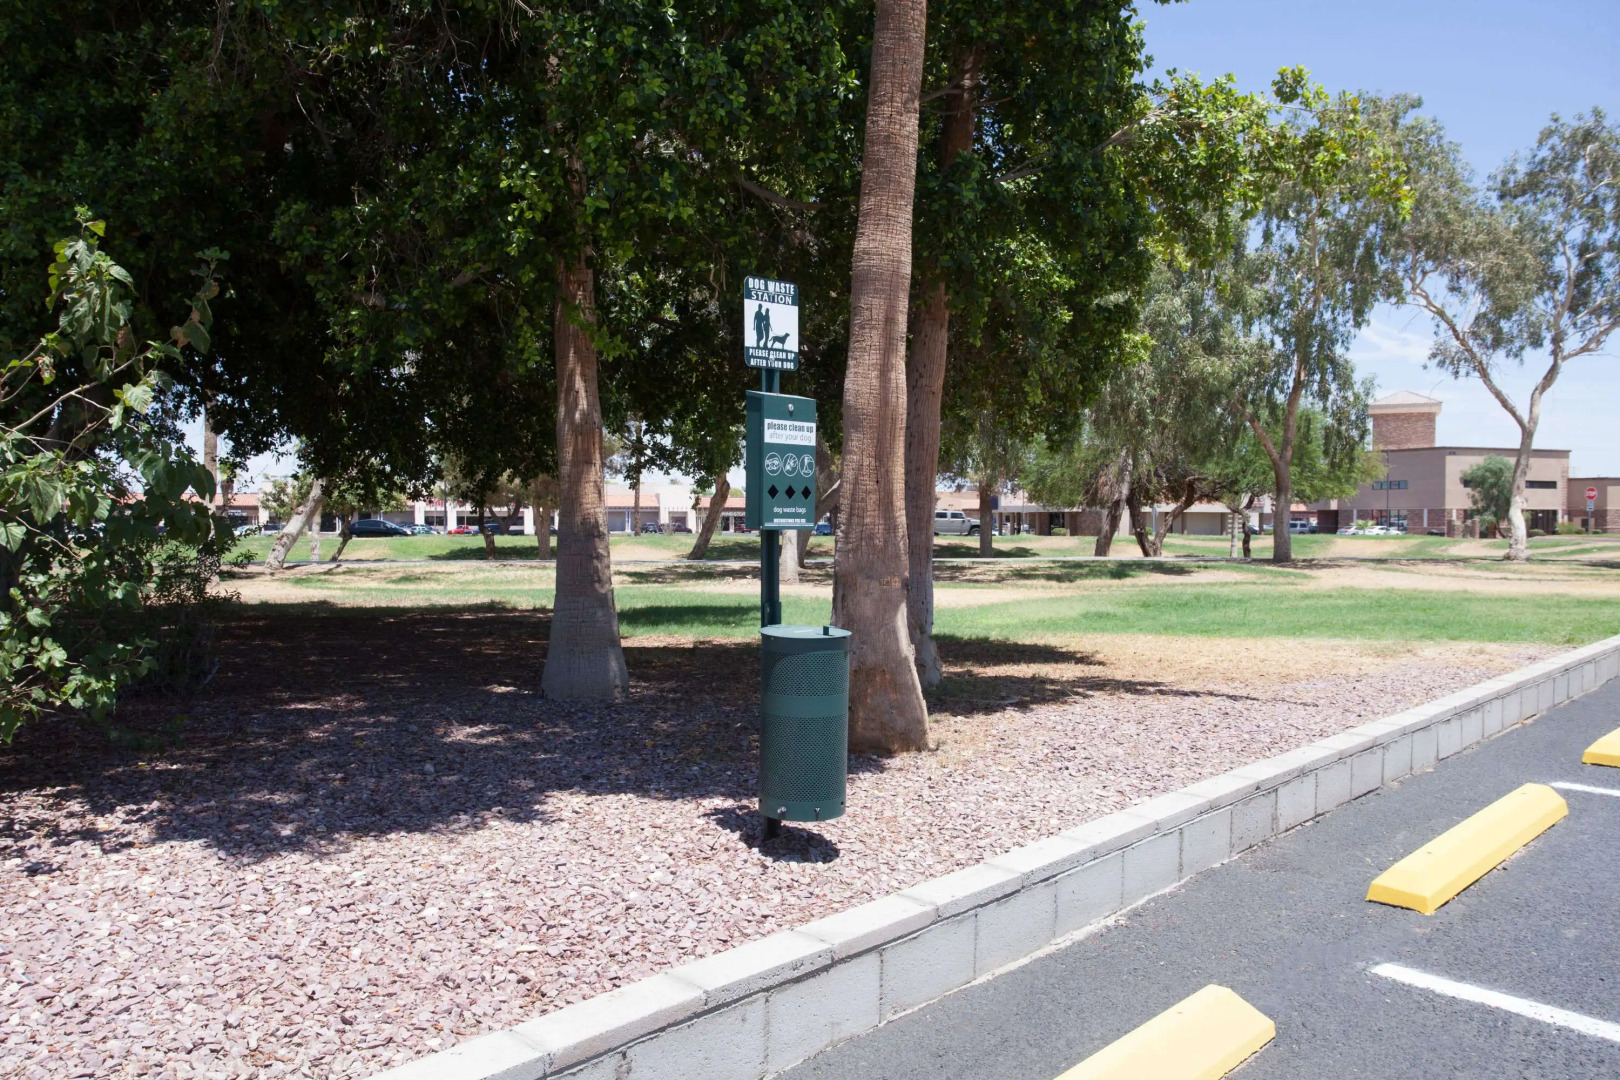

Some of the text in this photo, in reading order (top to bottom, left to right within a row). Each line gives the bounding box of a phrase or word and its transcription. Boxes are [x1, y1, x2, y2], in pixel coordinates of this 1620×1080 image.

[748, 278, 794, 294] DOG WASTE
[751, 291, 792, 304] STATION
[749, 348, 795, 360] PLEASE CLEAN UP
[750, 358, 794, 369] AFTER YOUR DOG
[767, 421, 814, 434] please clean up
[769, 431, 812, 443] after your dog
[773, 506, 783, 514] dog
[796, 506, 806, 514] bags
